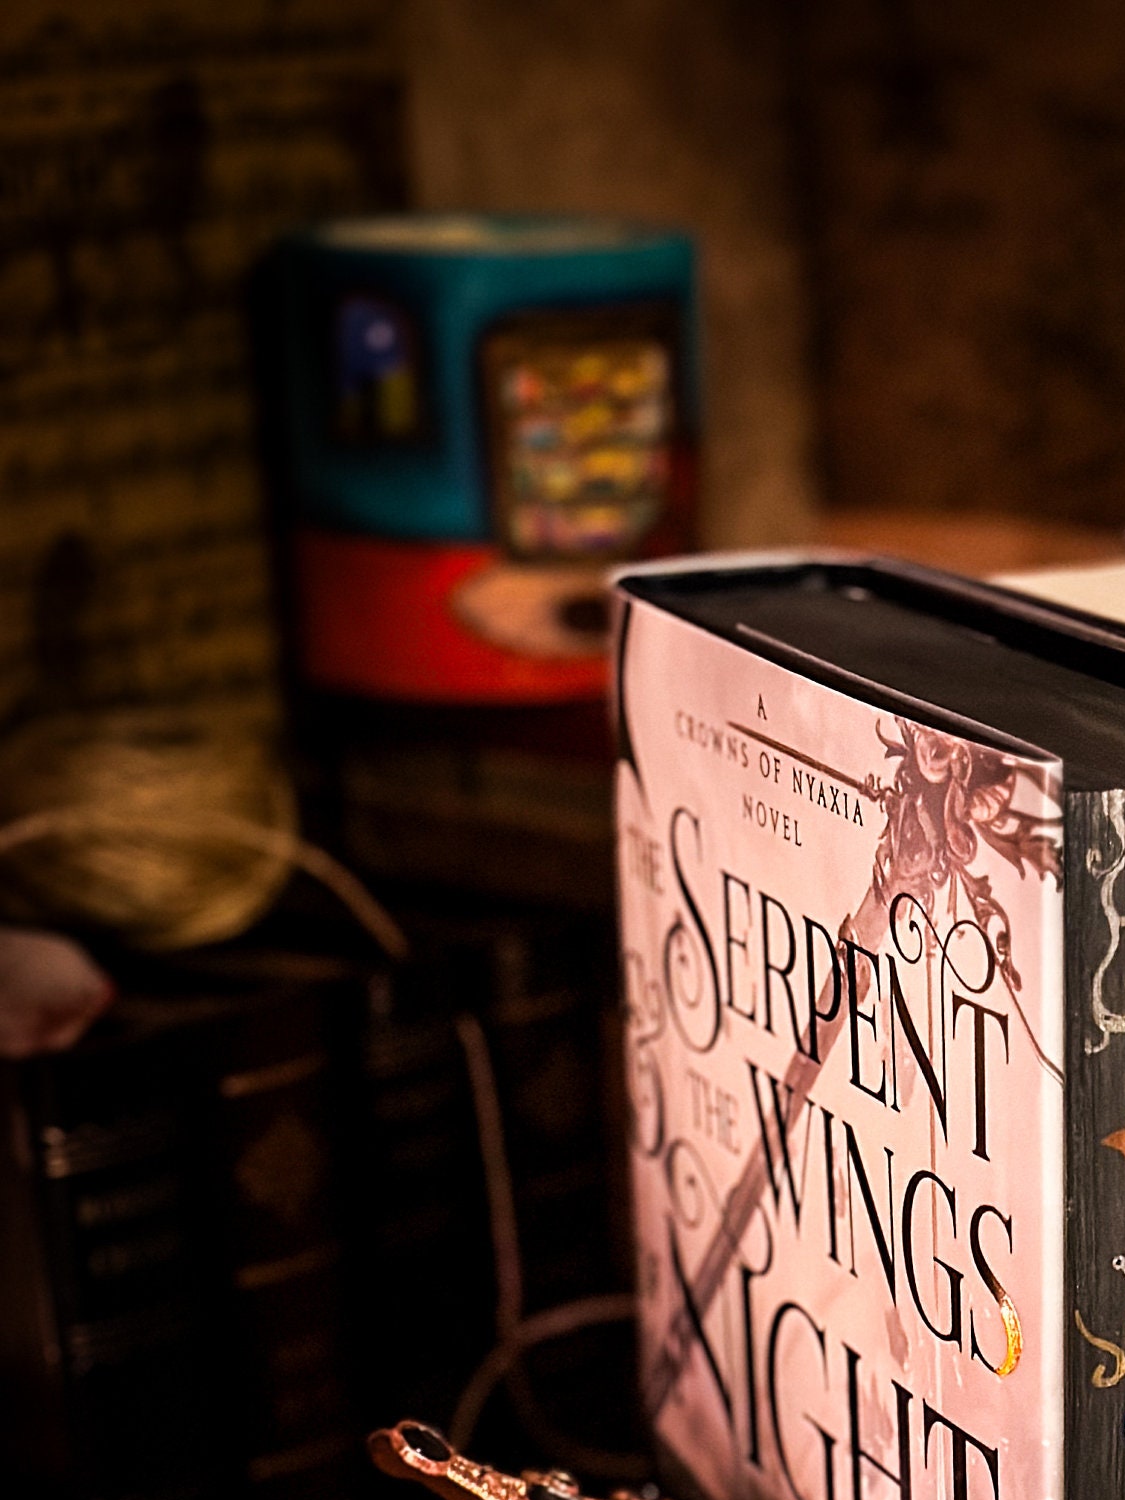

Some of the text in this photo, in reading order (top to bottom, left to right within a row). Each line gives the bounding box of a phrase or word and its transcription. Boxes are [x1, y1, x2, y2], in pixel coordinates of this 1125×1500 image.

[757, 695, 767, 721] A
[676, 711, 865, 827] CROWNS OF NYAXIA
[742, 796, 803, 847] NOVEL
[664, 806, 1010, 1162] SERPENT
[685, 1059, 1023, 1377] THE WINGS
